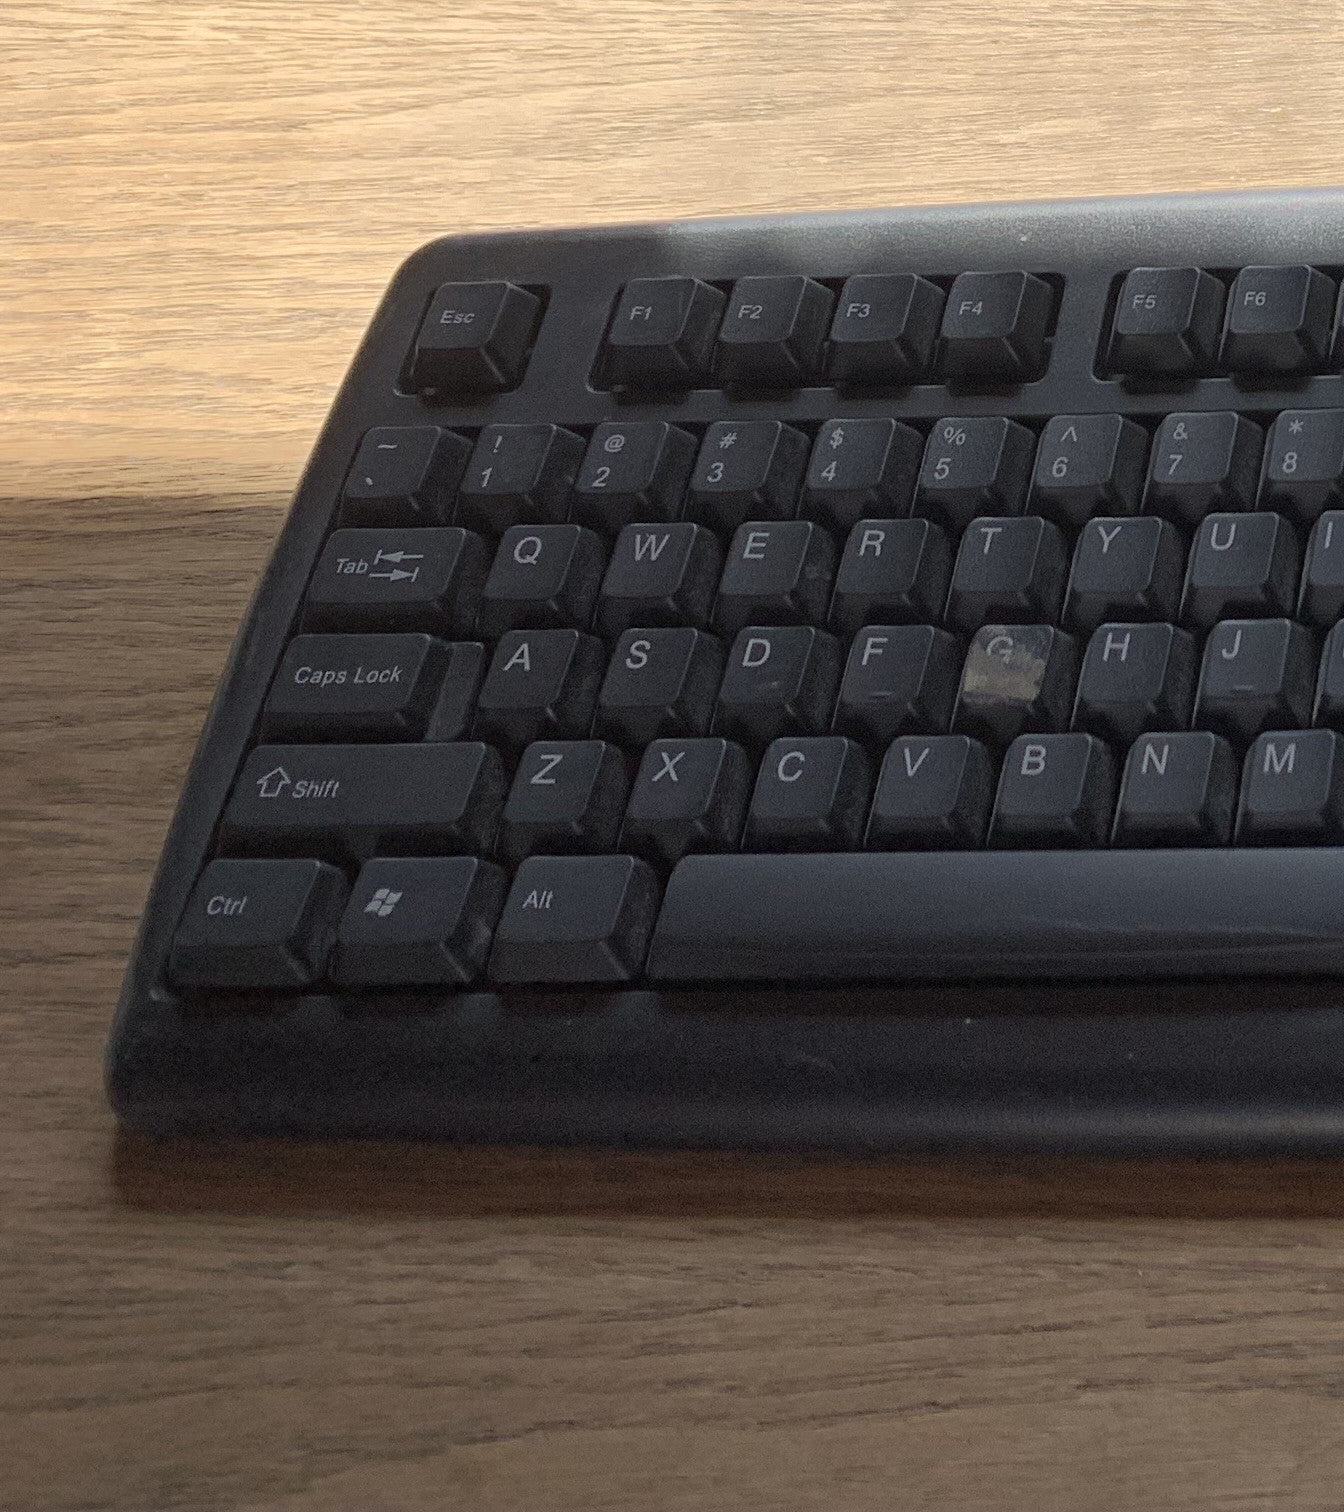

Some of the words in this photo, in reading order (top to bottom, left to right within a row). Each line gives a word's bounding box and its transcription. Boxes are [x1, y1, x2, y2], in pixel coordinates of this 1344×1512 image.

[737, 305, 761, 319] F2
[847, 303, 870, 318] F3
[959, 301, 983, 316] F4
[1132, 295, 1156, 309] F5
[1244, 292, 1266, 306] F6
[440, 310, 476, 325] Esc
[630, 306, 652, 321] F1
[706, 463, 724, 483] 3
[821, 462, 837, 482] 4
[933, 457, 951, 480] 5
[1051, 457, 1069, 478] 6
[1169, 454, 1183, 475] 7
[1282, 452, 1297, 473] 8
[480, 467, 493, 486] 1
[591, 467, 611, 487] 2
[742, 532, 769, 559] E
[857, 530, 886, 557] R
[980, 527, 1002, 555] T
[1098, 525, 1122, 553] Y
[1210, 523, 1237, 551] U
[1324, 520, 1334, 548] I
[513, 536, 543, 565] Q
[633, 534, 670, 562] W
[336, 557, 368, 576] Tab
[503, 642, 532, 672] A
[625, 639, 651, 670] S
[742, 638, 771, 667] D
[862, 636, 889, 666] F
[986, 635, 1014, 663] G
[1101, 634, 1130, 663] H
[1222, 630, 1244, 660] J
[294, 666, 347, 688] Caps
[355, 664, 402, 684] Lock
[531, 755, 564, 785] Z
[651, 751, 687, 783] X
[777, 750, 807, 783] C
[903, 746, 931, 778] V
[1021, 744, 1047, 776] B
[1140, 743, 1170, 776] N
[1263, 742, 1297, 774] M
[292, 779, 340, 800] Shift
[206, 896, 247, 917] Ctrl
[521, 890, 553, 910] Alt
